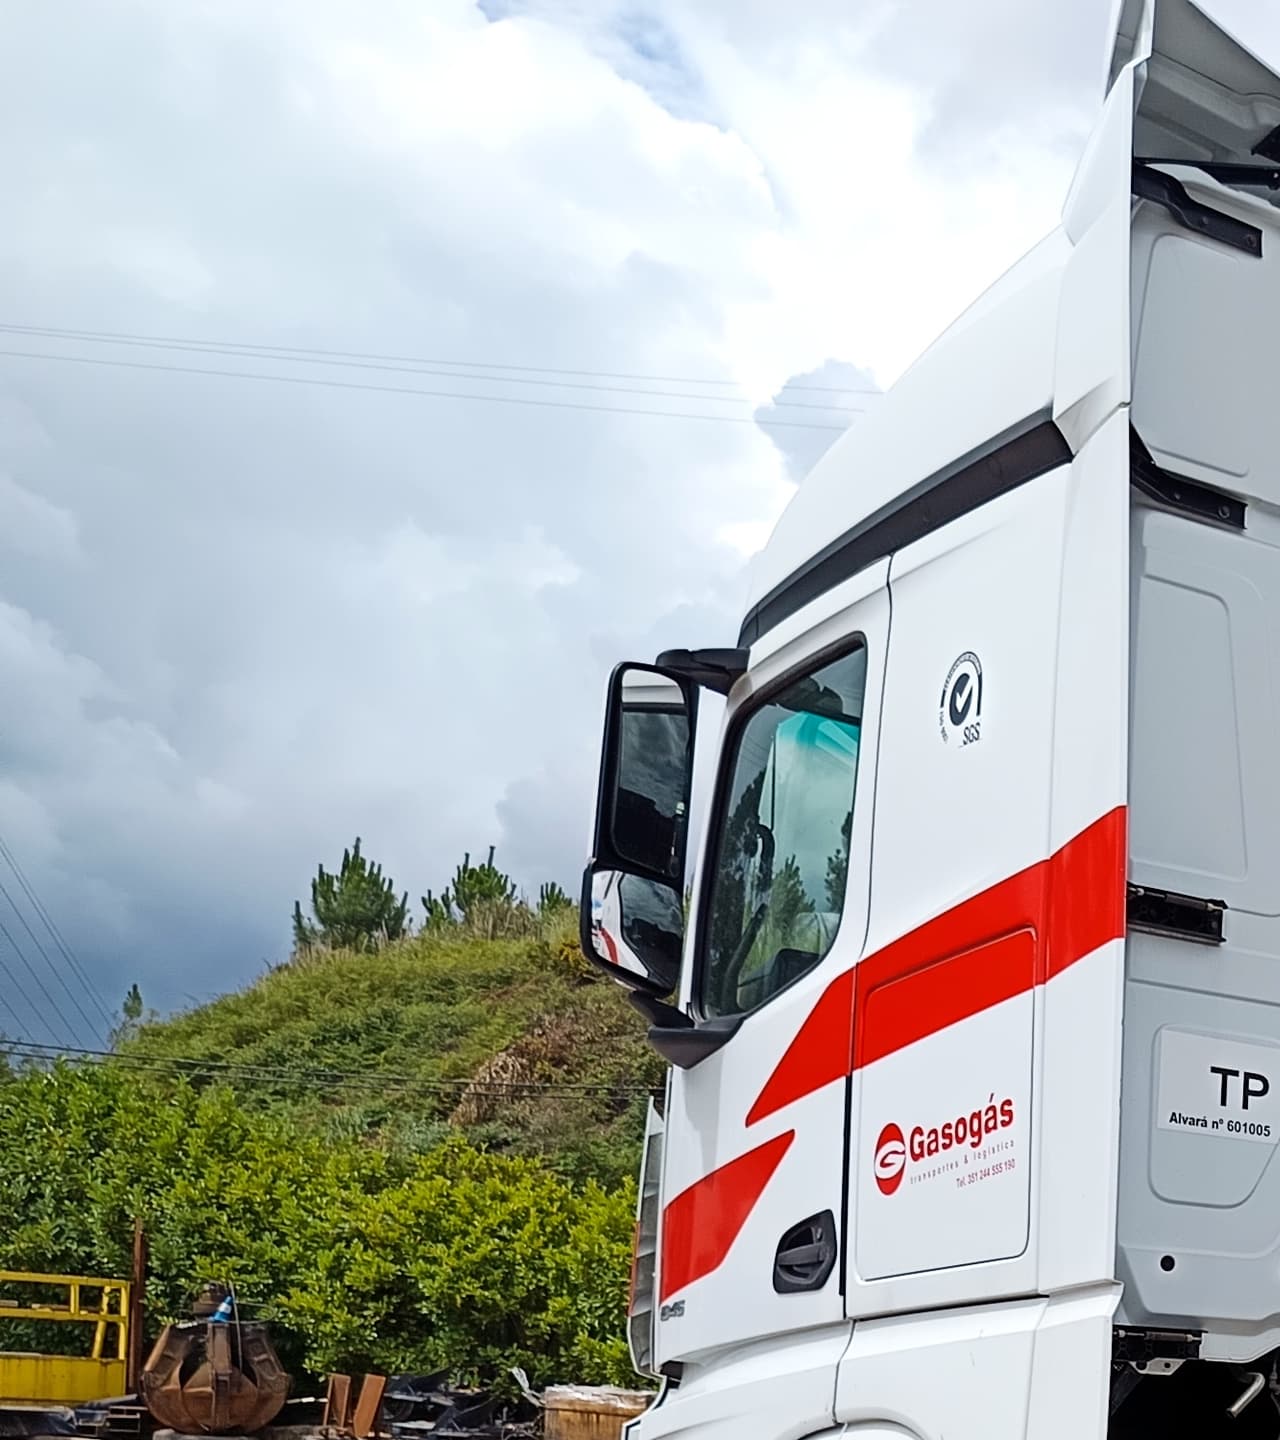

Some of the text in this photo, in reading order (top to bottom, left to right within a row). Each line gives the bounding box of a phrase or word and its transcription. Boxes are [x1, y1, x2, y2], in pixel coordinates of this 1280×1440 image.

[962, 722, 981, 745] SGS
[1210, 1066, 1270, 1110] TP
[909, 1092, 1014, 1162] Gasogás
[1169, 1111, 1208, 1128] Alvará
[1227, 1120, 1271, 1137] 601005
